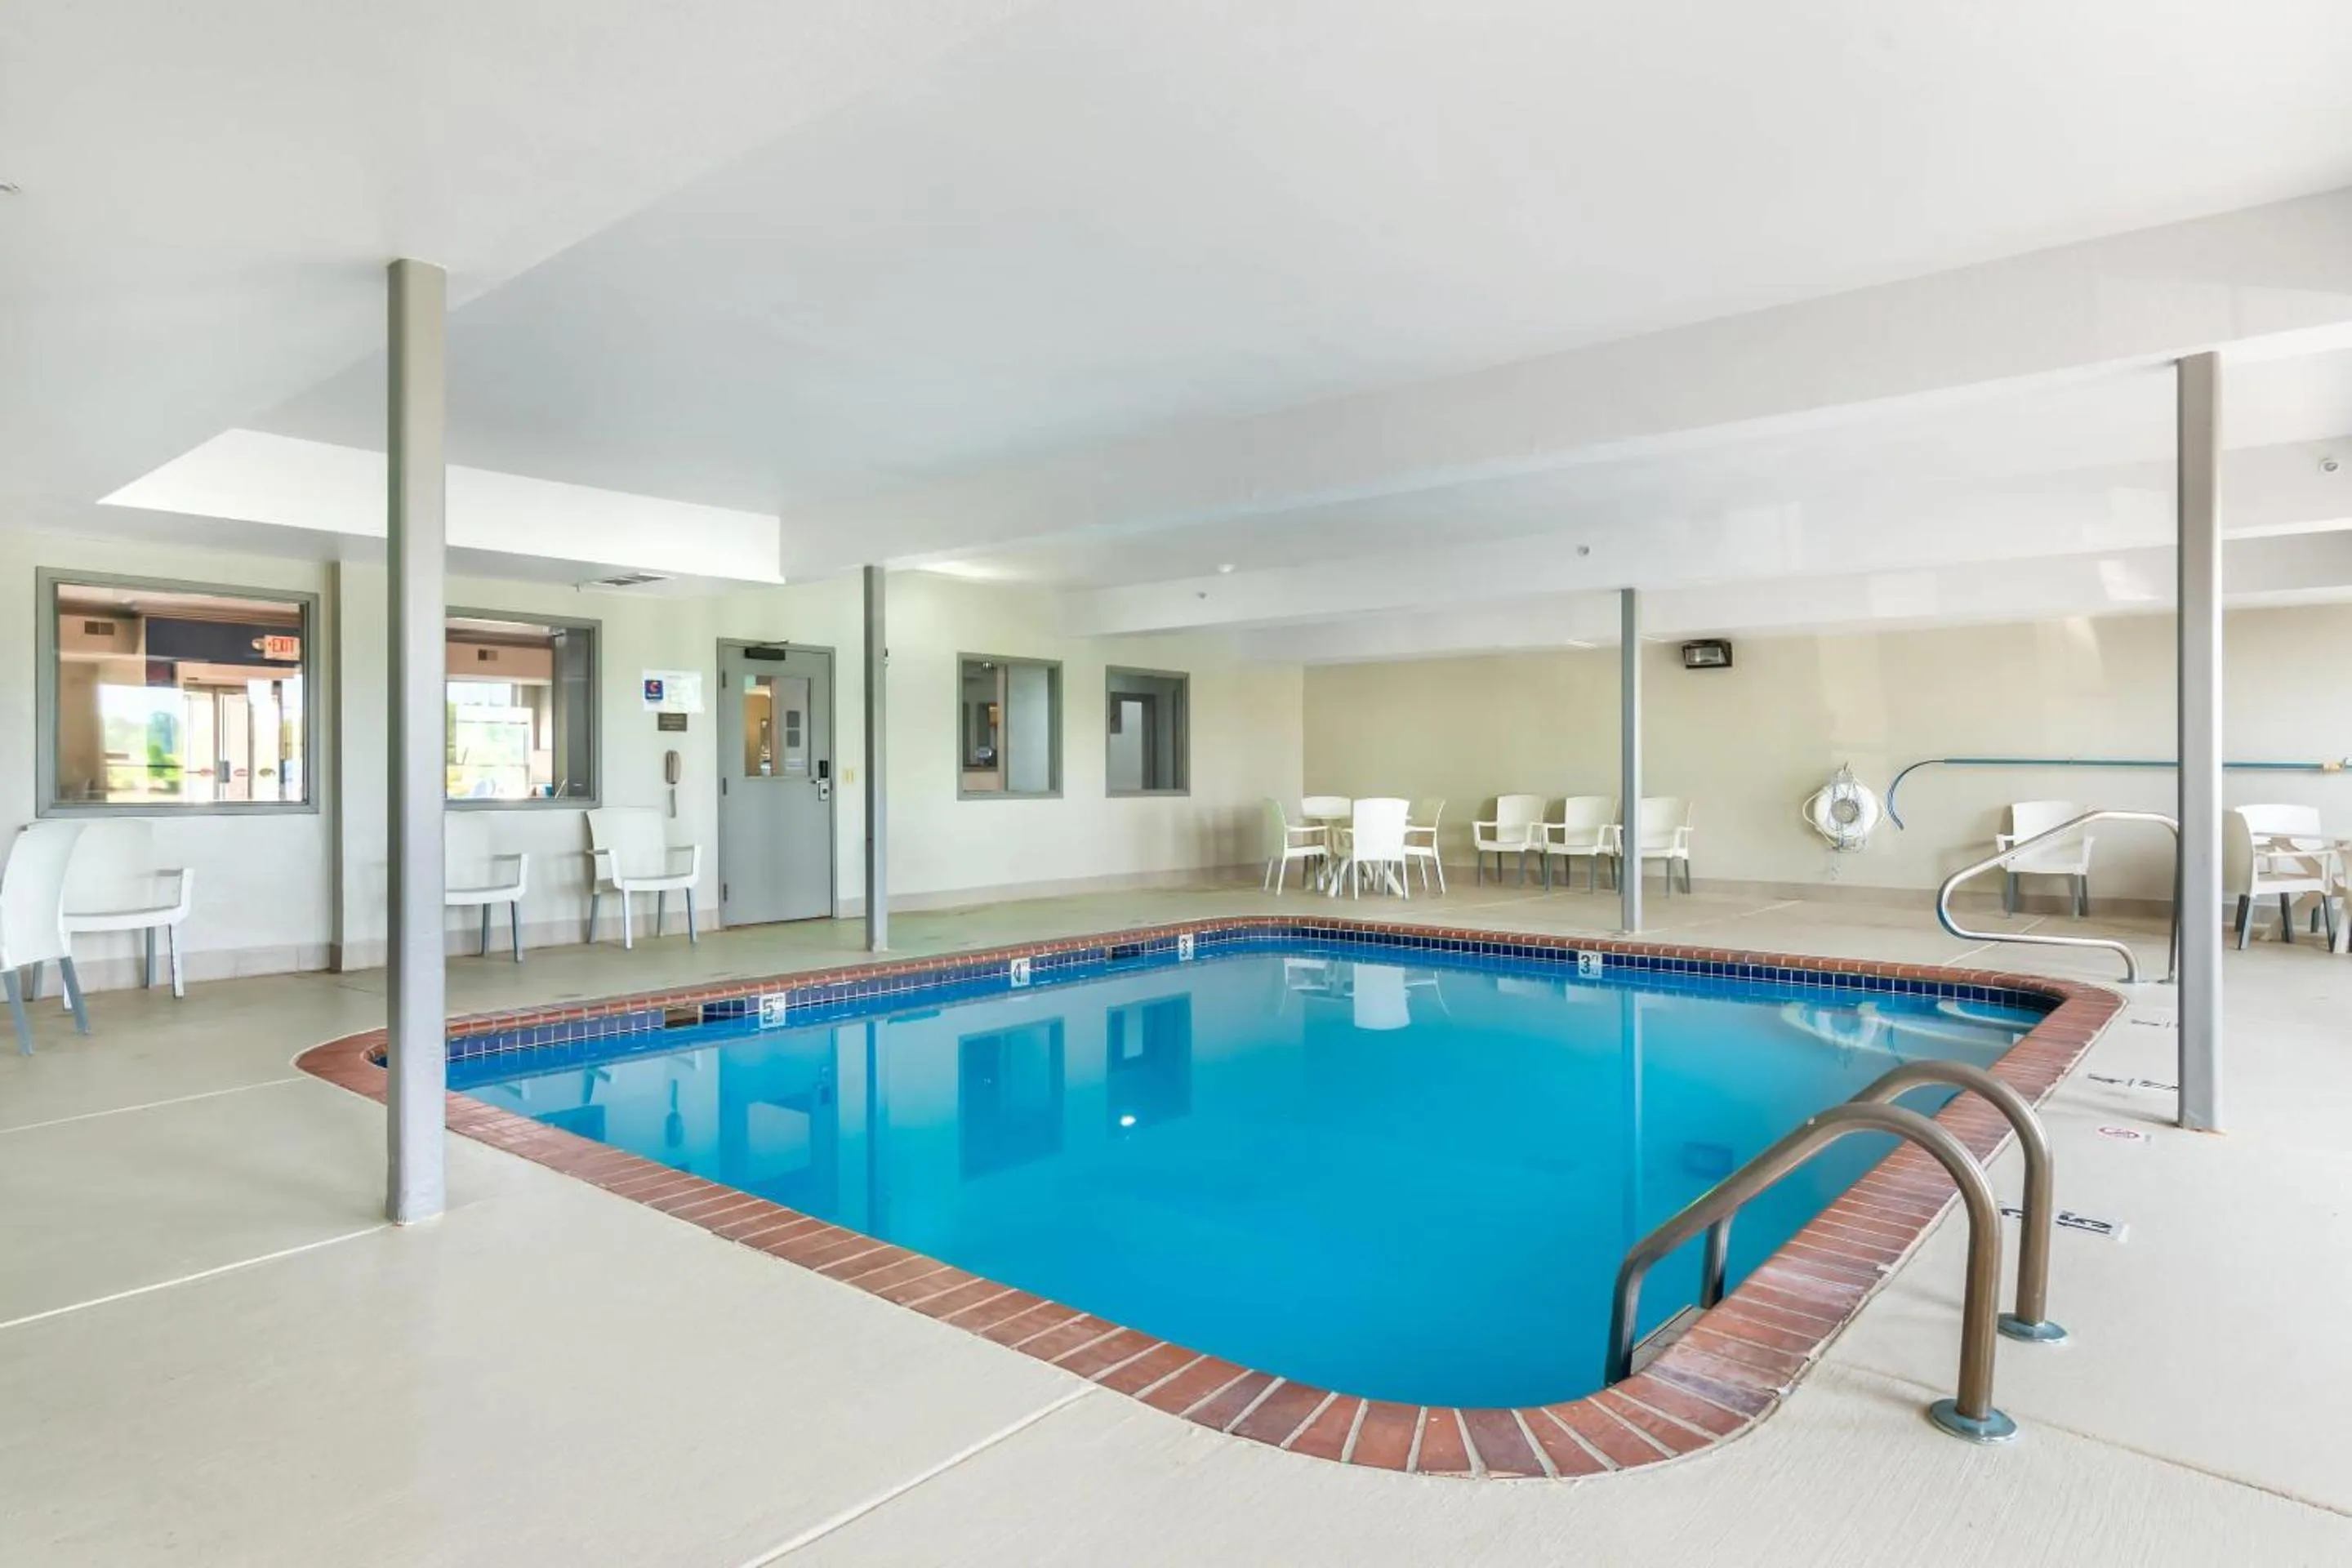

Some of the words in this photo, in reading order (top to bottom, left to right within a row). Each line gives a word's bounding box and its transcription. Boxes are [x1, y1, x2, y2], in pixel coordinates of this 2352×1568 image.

[272, 638, 295, 653] EXIT
[1580, 954, 1591, 974] 3
[763, 997, 774, 1023] 5
